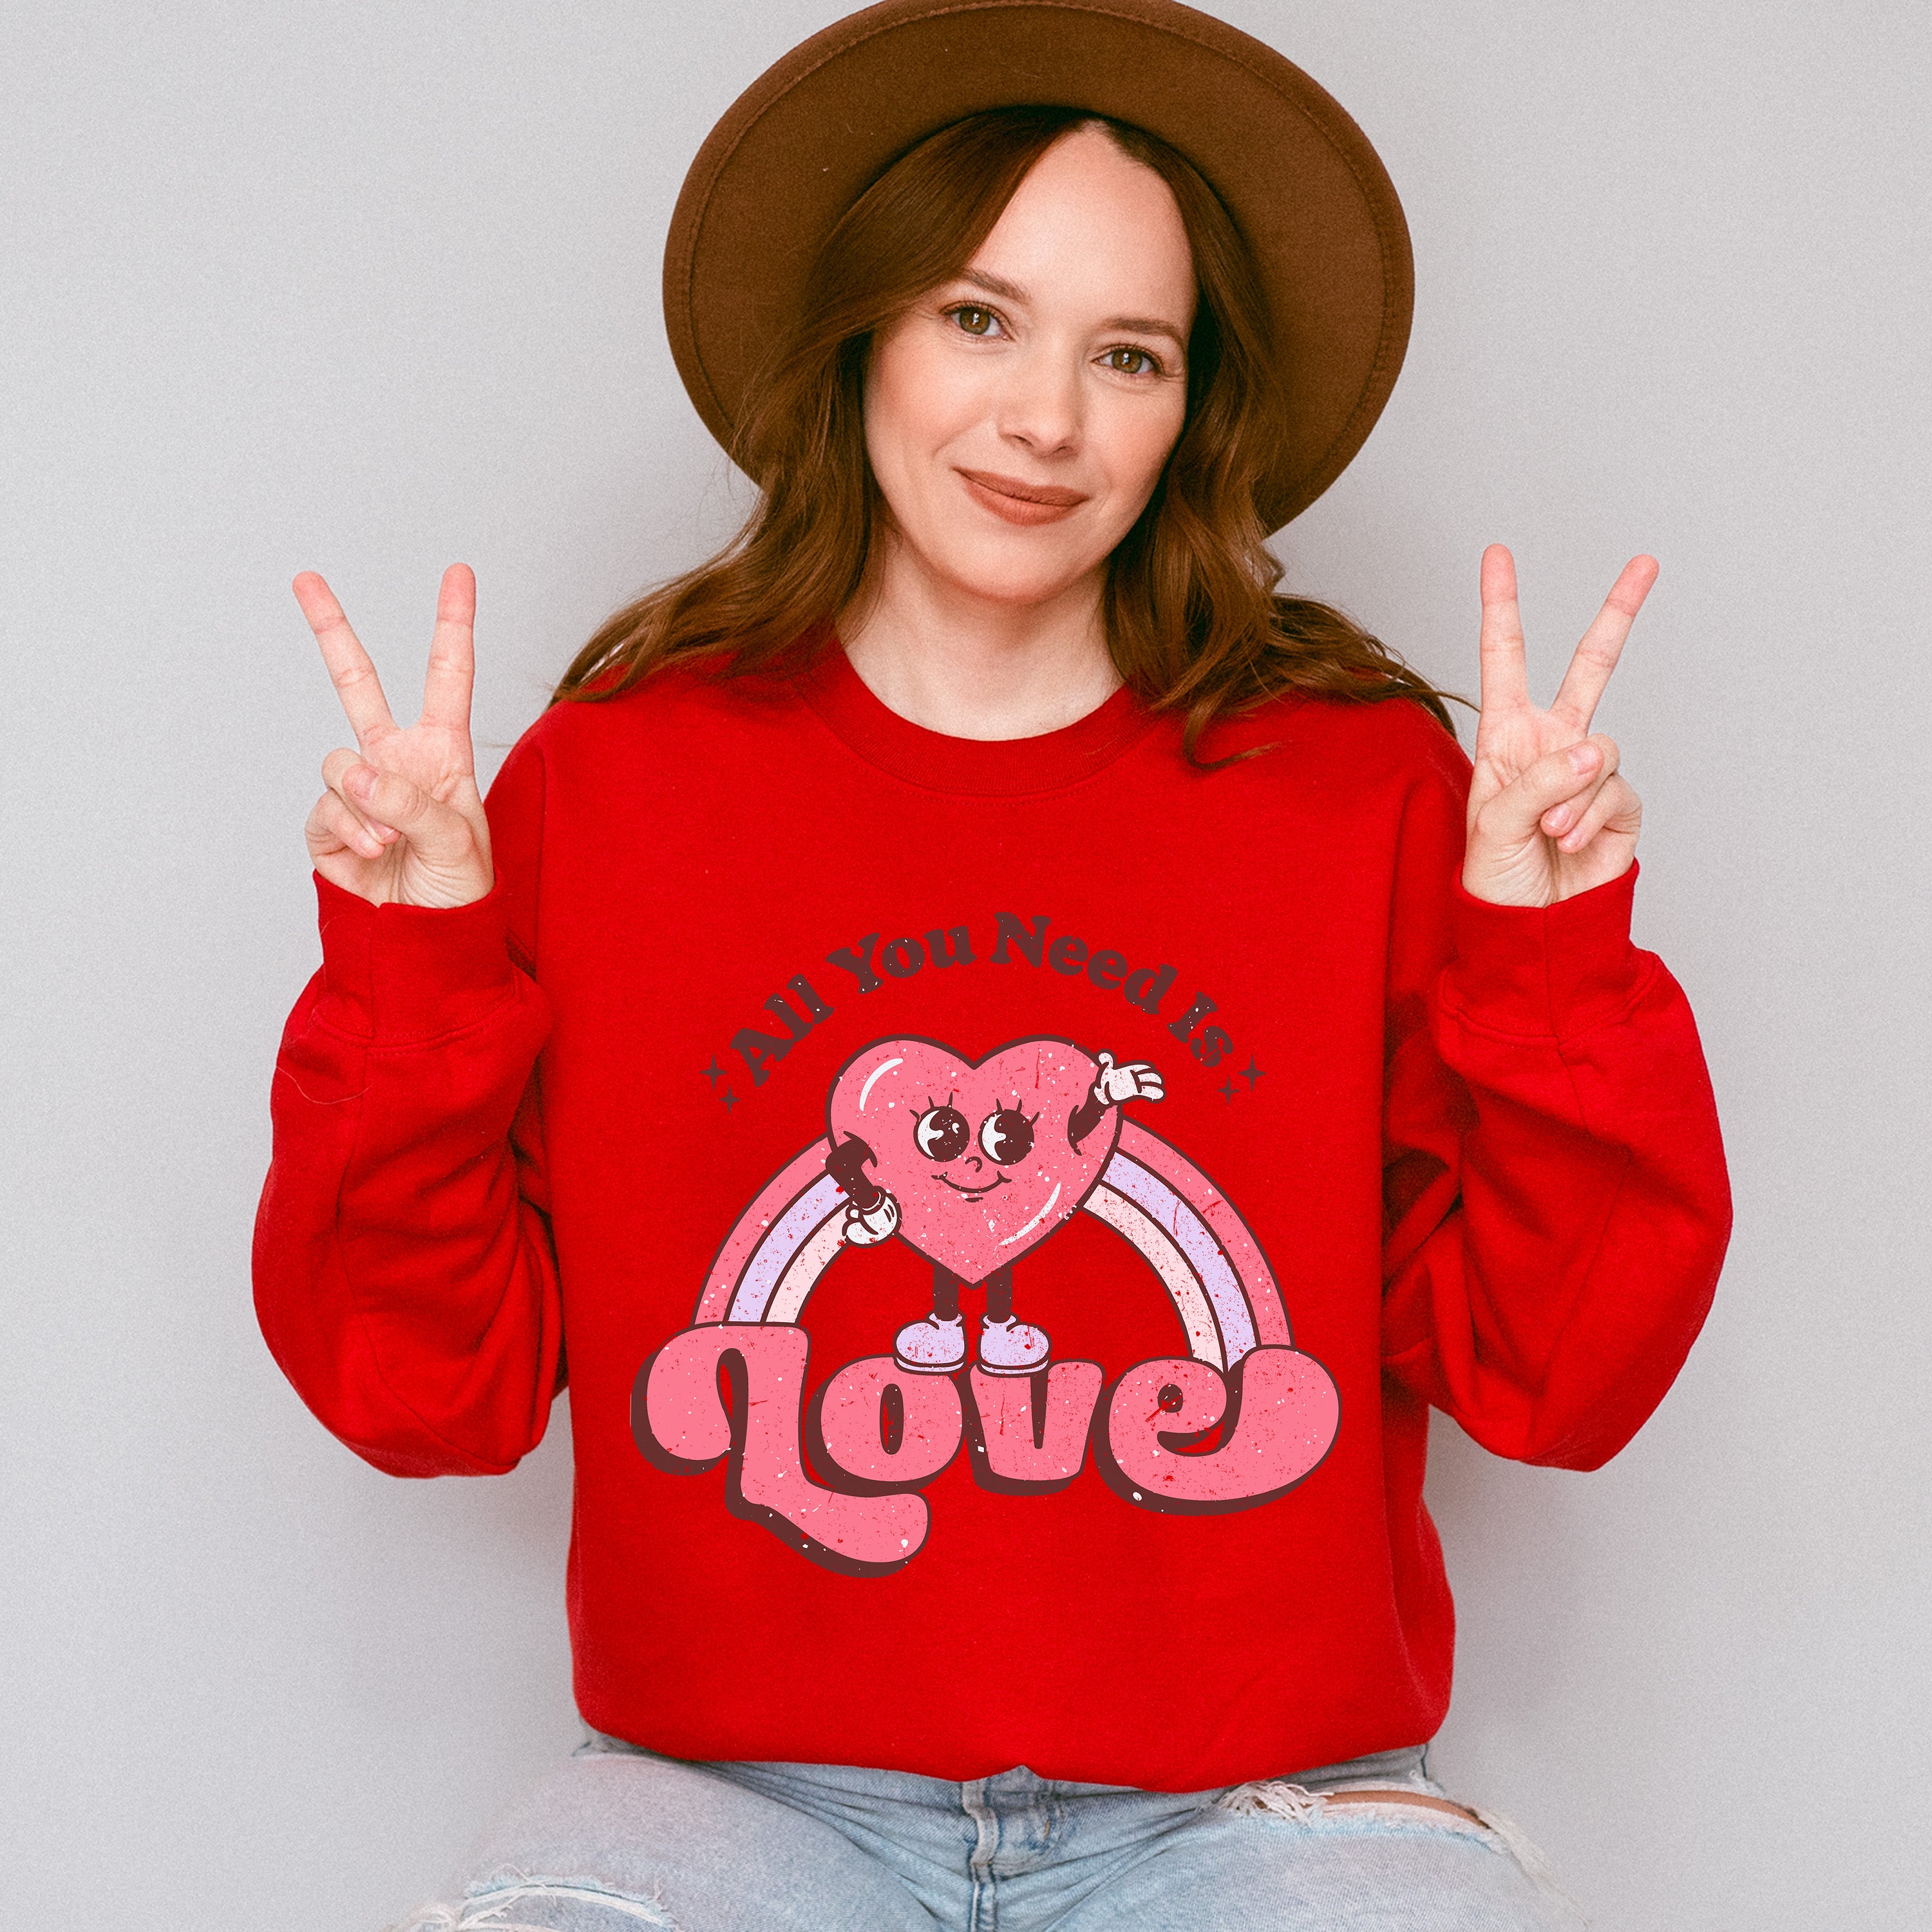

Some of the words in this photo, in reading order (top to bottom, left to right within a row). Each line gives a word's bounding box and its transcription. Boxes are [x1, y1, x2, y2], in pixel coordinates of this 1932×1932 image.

[729, 973, 835, 1088] All
[825, 925, 977, 994] You
[989, 911, 1178, 1015] Need
[1167, 991, 1234, 1068] Is
[630, 1322, 1342, 1578] Love
